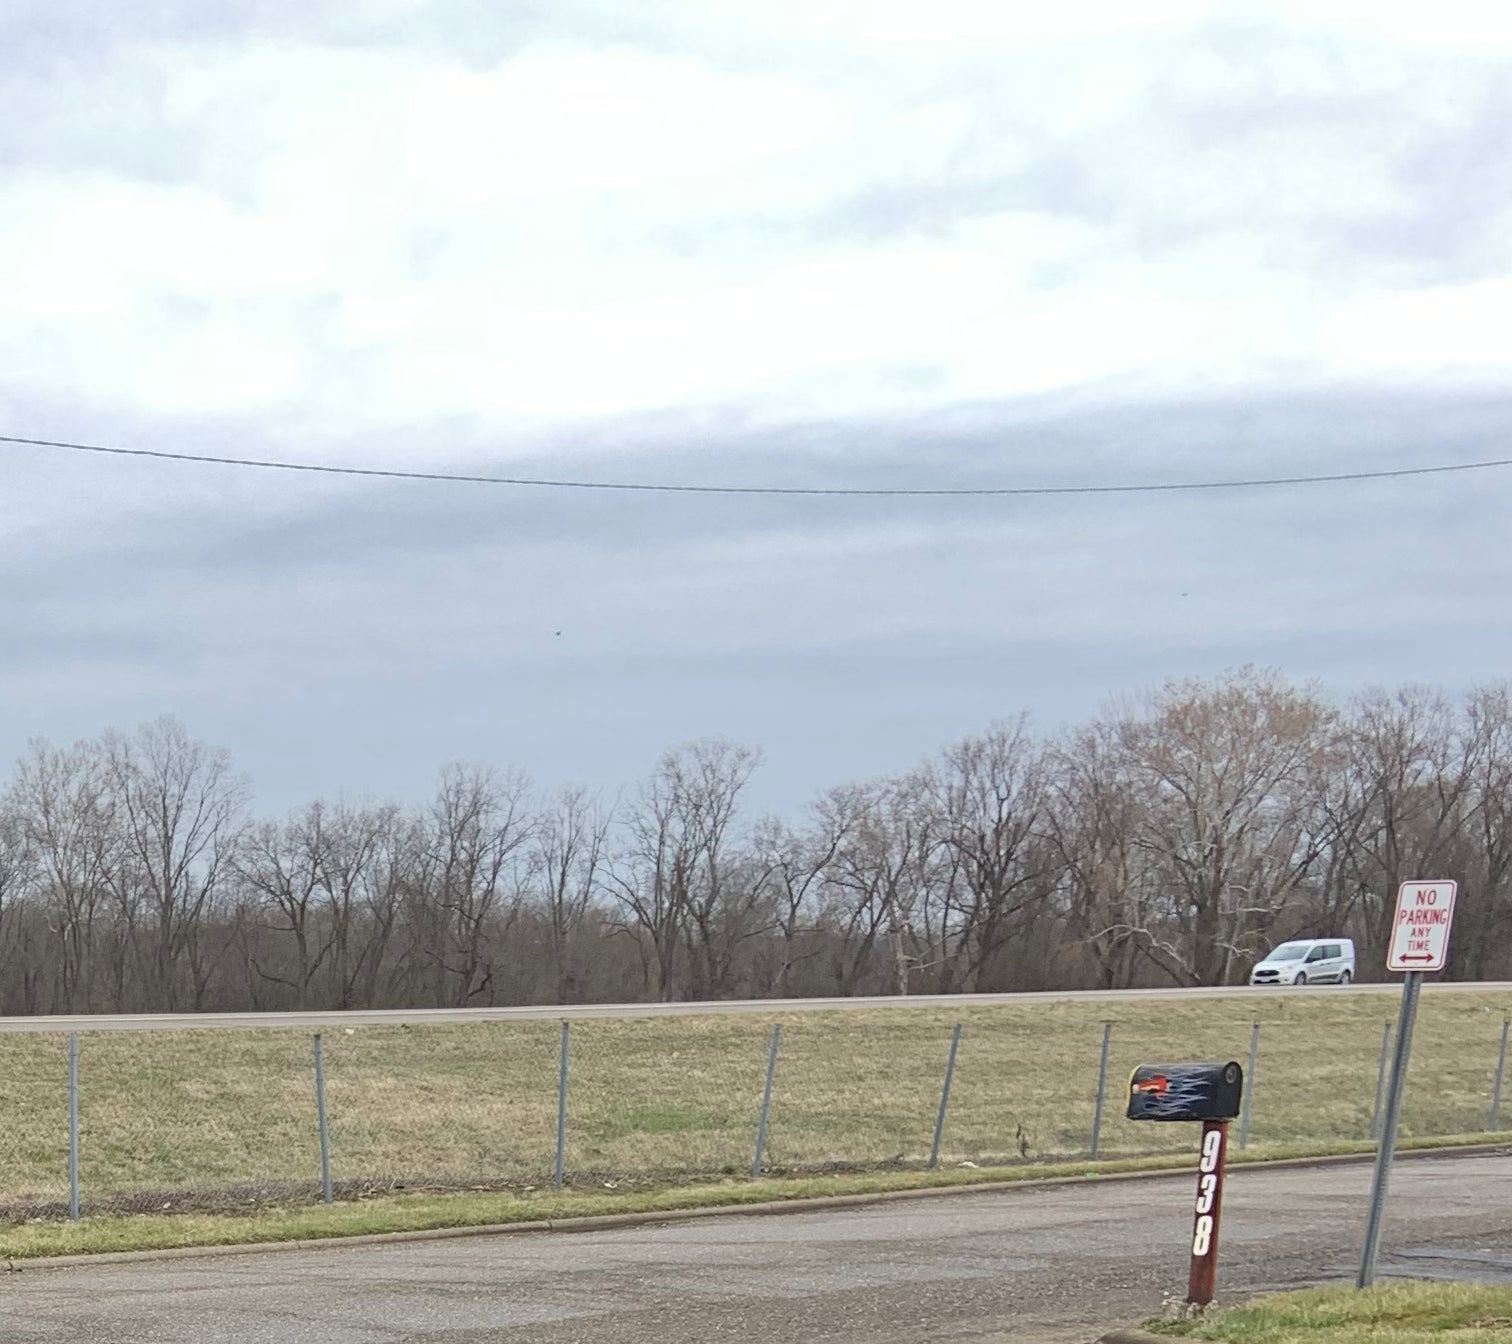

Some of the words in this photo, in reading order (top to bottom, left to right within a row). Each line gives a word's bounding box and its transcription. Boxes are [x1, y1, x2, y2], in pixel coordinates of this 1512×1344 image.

[1416, 890, 1437, 906] NO
[1399, 908, 1448, 925] PARKING
[1409, 927, 1431, 938] ANY
[1408, 940, 1431, 951] TIME
[1193, 1130, 1222, 1256] 938
